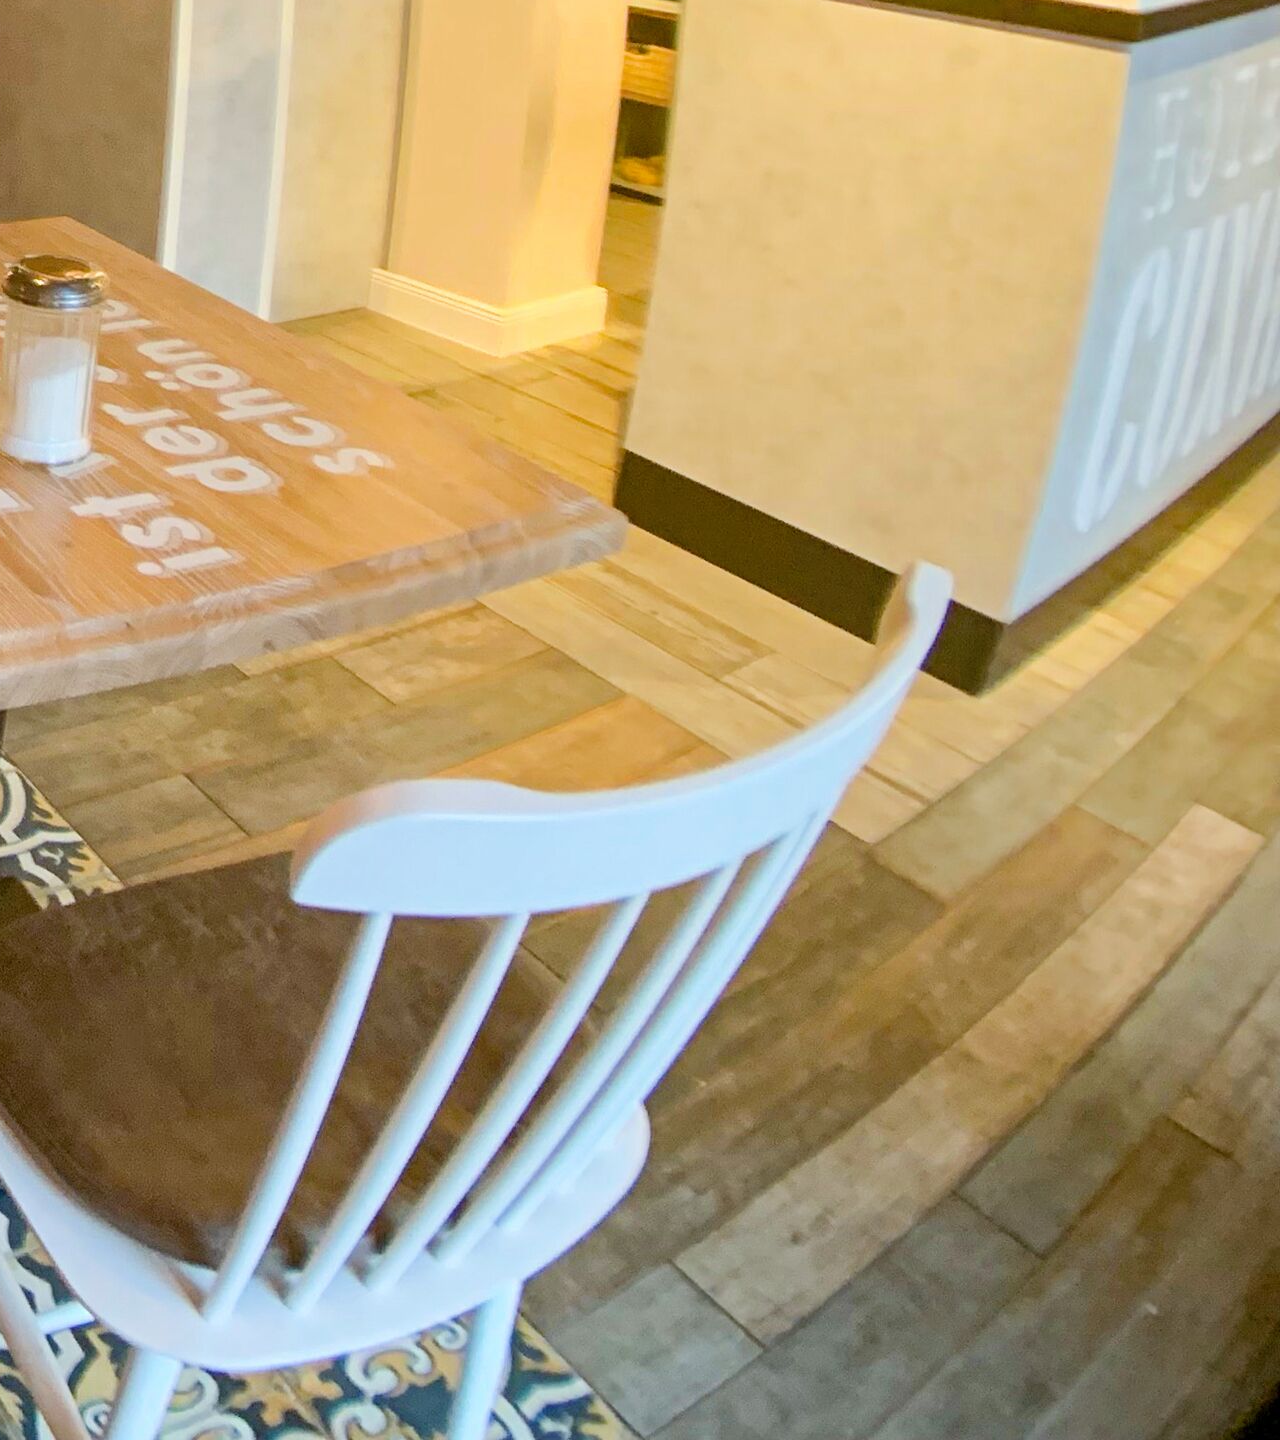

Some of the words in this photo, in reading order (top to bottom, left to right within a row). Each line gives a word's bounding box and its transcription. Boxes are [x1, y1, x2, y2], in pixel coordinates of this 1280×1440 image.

[100, 402, 273, 493] der
[137, 339, 386, 476] schön
[72, 490, 234, 576] ist
